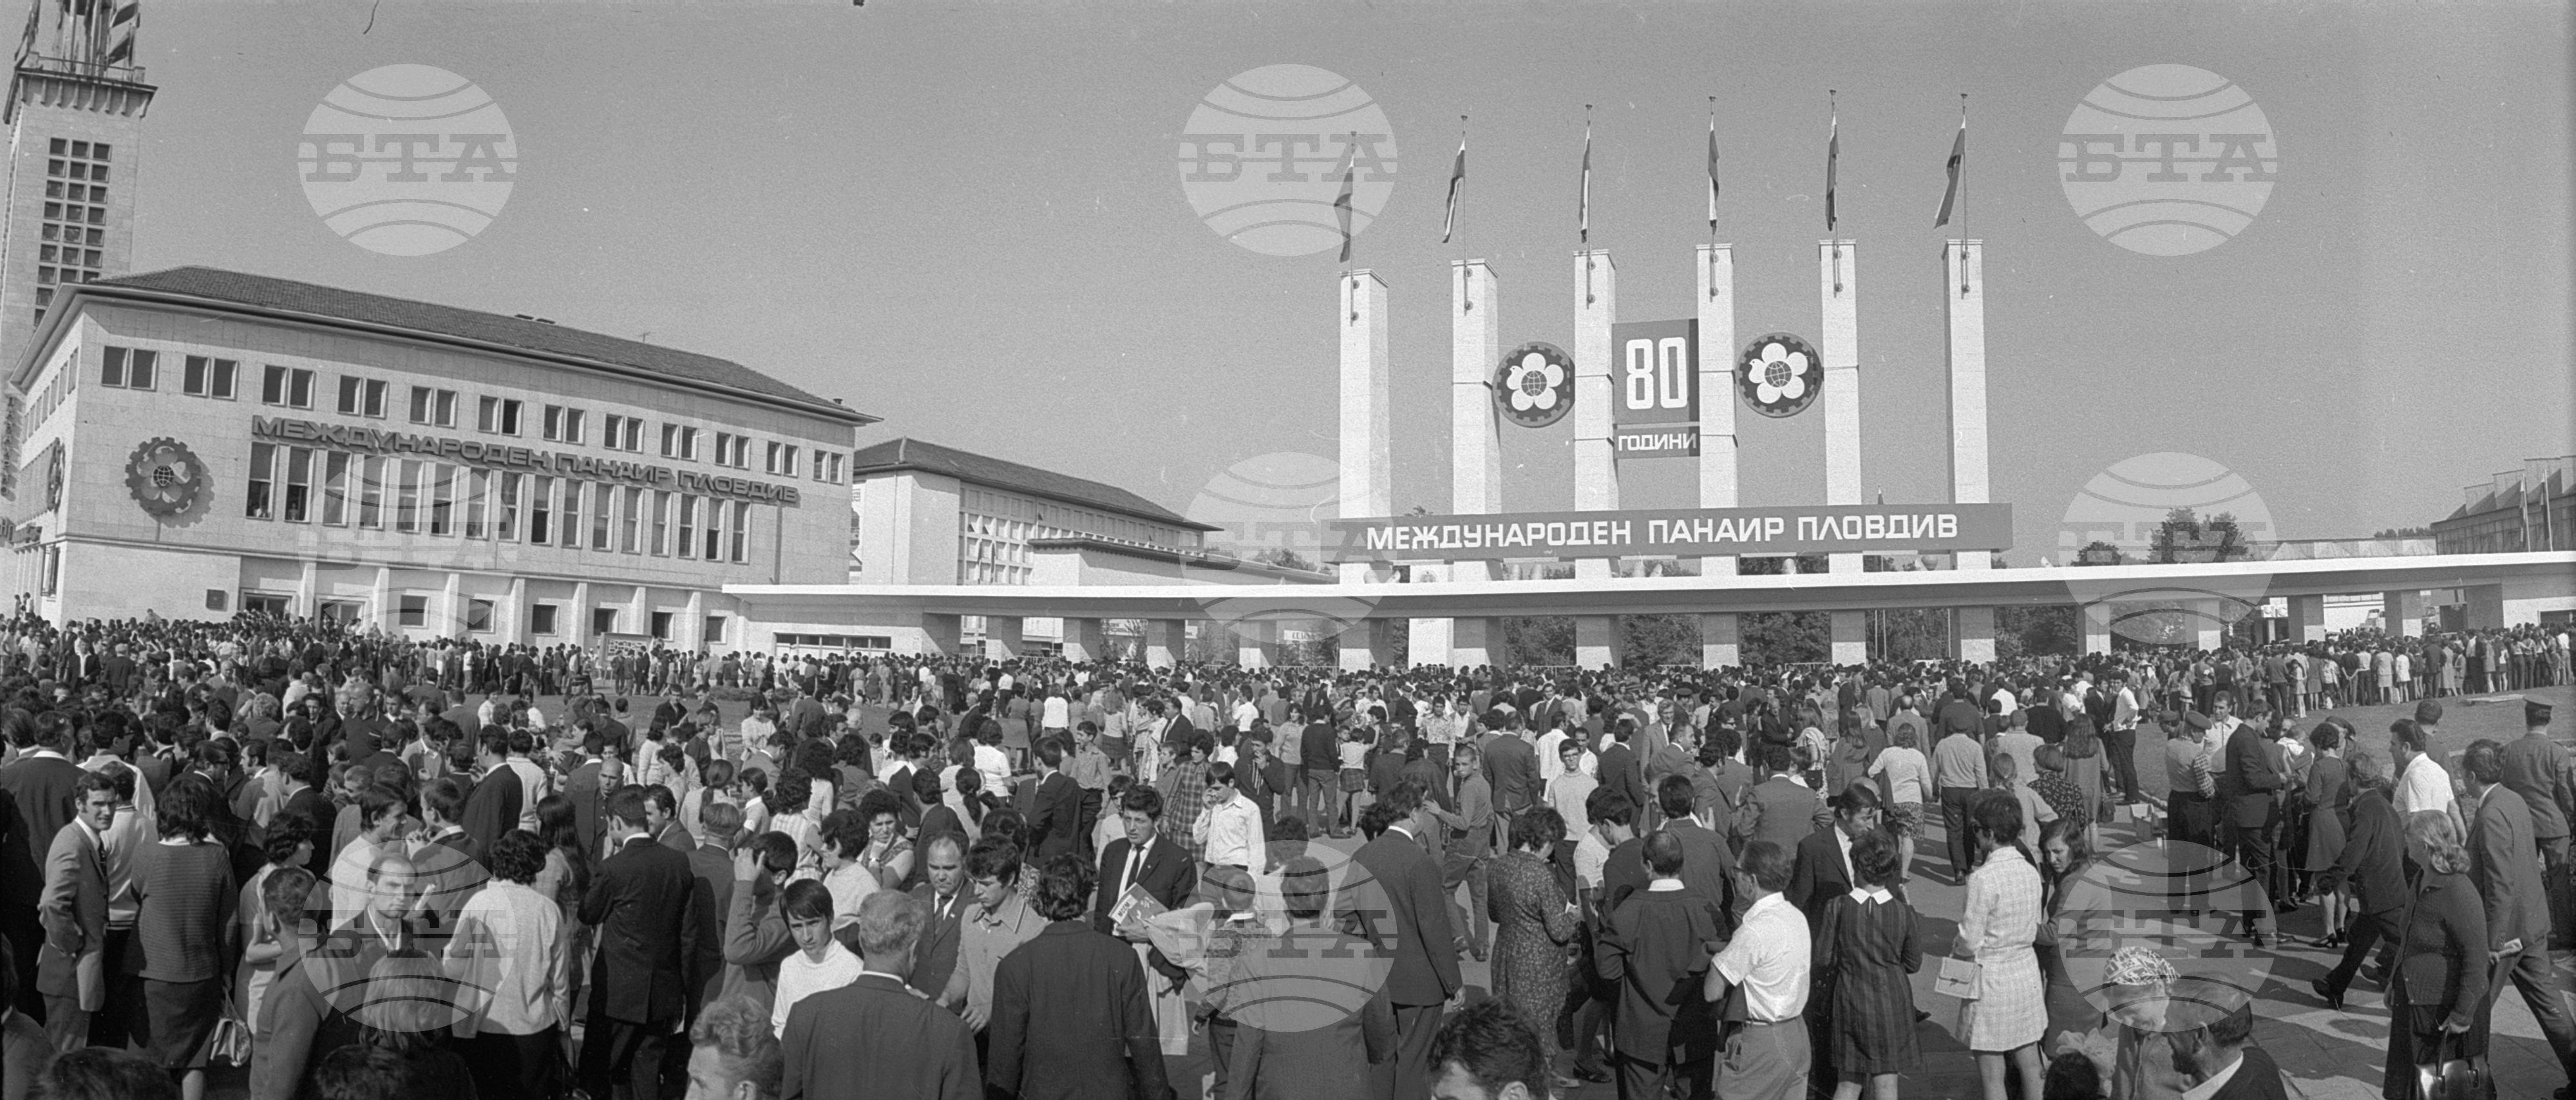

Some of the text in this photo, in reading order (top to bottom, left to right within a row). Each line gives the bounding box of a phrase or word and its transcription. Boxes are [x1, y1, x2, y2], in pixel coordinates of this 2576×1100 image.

[1625, 337, 1688, 410] 80
[252, 415, 800, 503] МЕЖДУНАРОДЕН ПАНАИР ПЛОВДИВ
[1618, 433, 1696, 451] ГОДИНИ
[1367, 514, 1957, 550] МЕЖДУНАРОДЕН ПАНАИР ПЛОВДИВ
